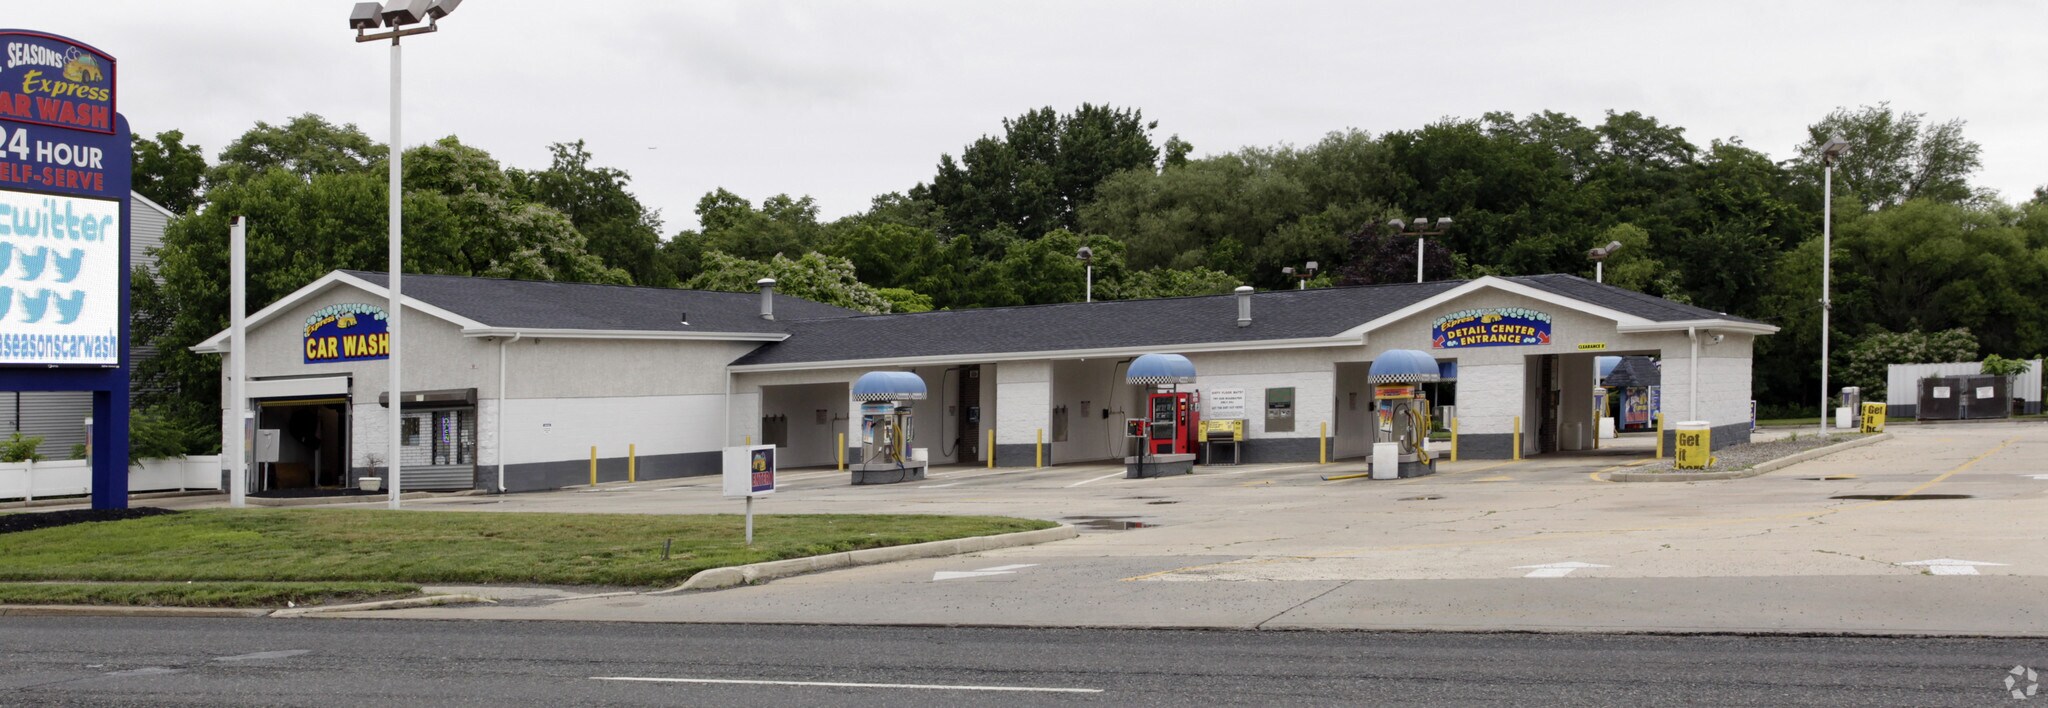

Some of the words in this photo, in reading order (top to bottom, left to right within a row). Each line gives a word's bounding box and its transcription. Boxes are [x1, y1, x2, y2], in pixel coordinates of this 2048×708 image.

[7, 42, 63, 69] SEASONS
[22, 69, 110, 102] Express
[0, 91, 32, 118] AR
[36, 97, 108, 129] WASH
[36, 140, 103, 169] HOUR
[0, 161, 104, 191] ELF-SERVE
[306, 315, 335, 336] Express
[1441, 316, 1476, 332] Express
[1447, 326, 1487, 339] DETAIL
[1491, 324, 1535, 336] CENTER
[0, 327, 117, 359] seasonscarwash
[306, 337, 339, 360] CAR
[342, 333, 389, 358] WASH
[1460, 334, 1522, 346] ENTRANCE
[1868, 405, 1883, 414] Get
[1679, 433, 1700, 446] Get
[1678, 448, 1687, 461] it
